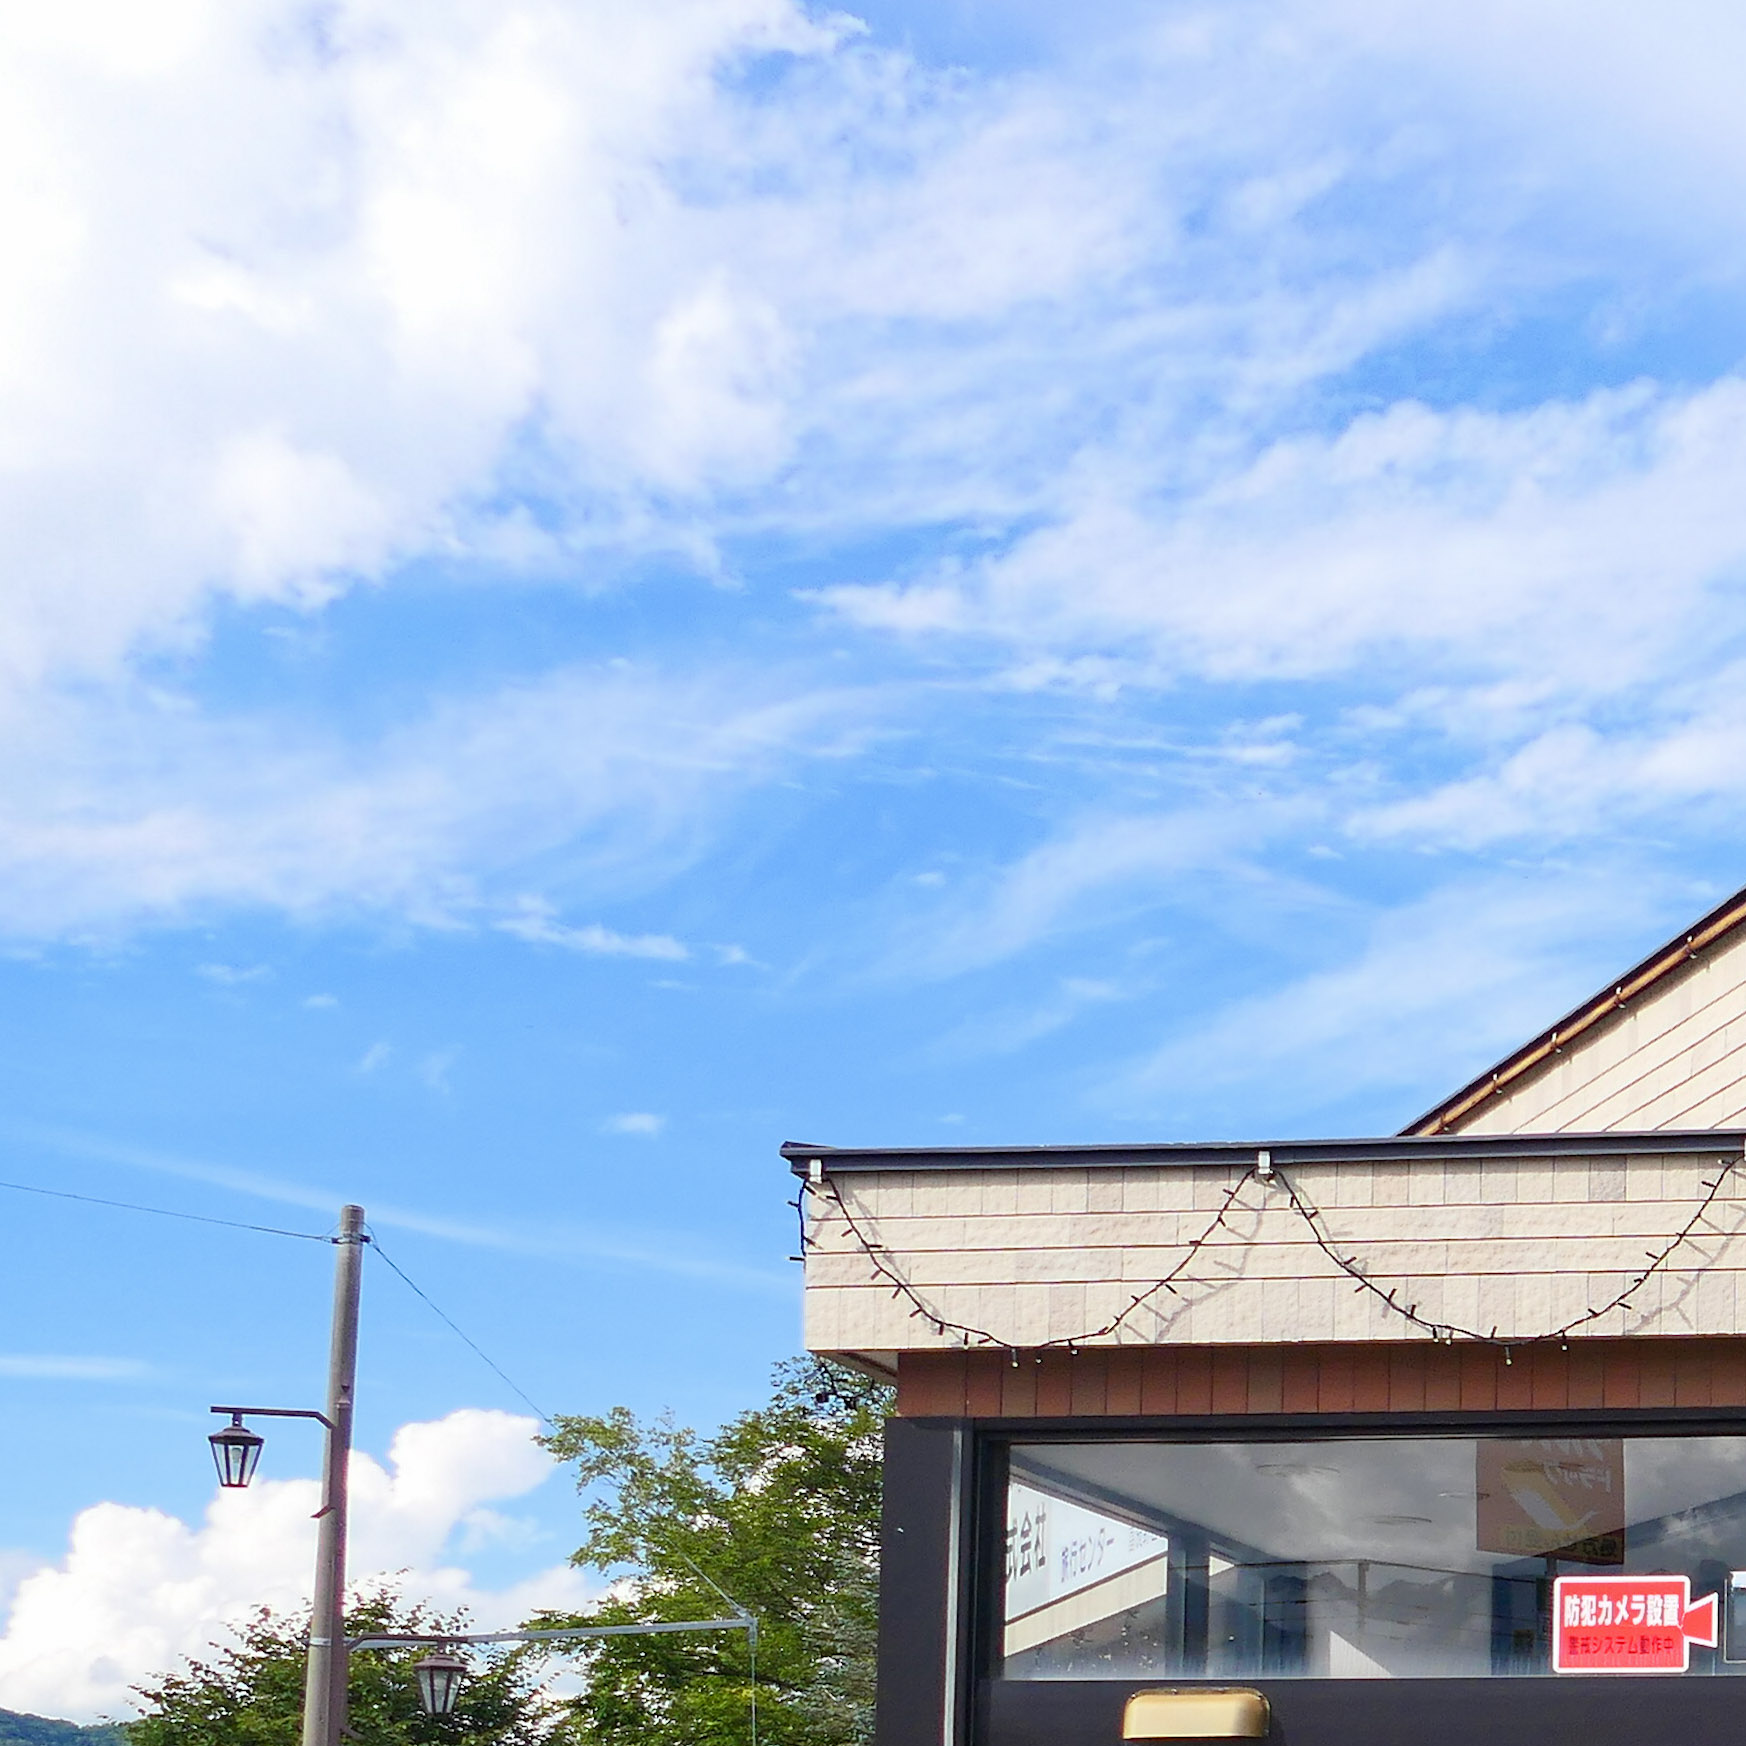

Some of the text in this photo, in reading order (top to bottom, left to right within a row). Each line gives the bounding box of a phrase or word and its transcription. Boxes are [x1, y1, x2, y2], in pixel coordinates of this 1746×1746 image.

[1564, 1594, 1679, 1628] 防犯カメラ設置
